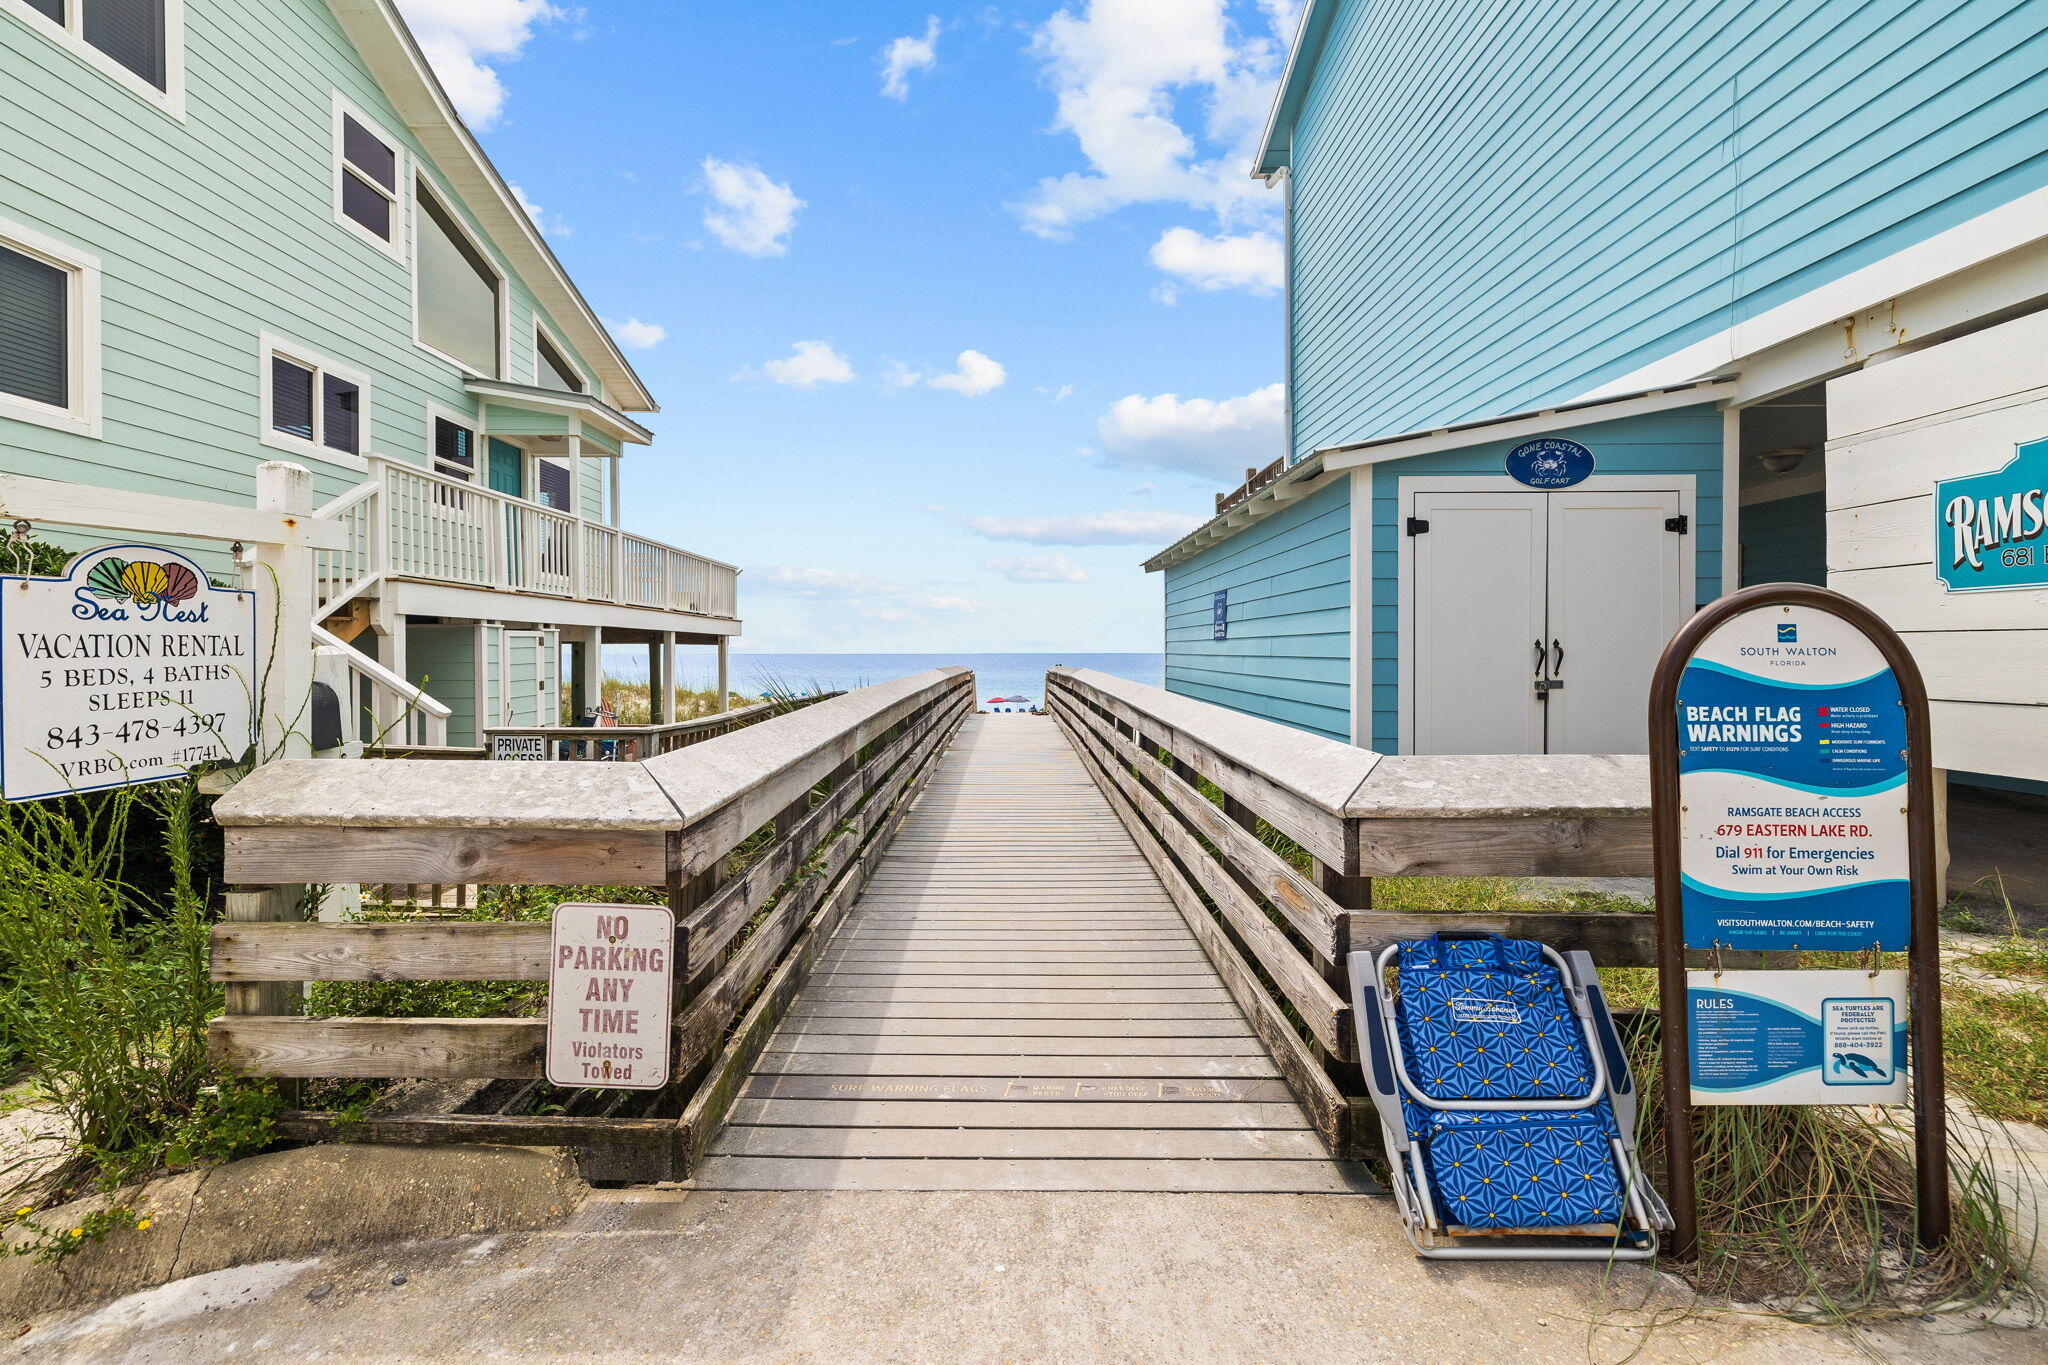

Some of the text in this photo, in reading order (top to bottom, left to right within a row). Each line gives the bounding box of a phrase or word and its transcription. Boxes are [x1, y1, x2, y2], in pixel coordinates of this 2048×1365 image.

[1518, 442, 1584, 458] GONE COASTAL
[1945, 488, 2048, 571] RAMS
[2001, 546, 2034, 567] 681
[72, 586, 208, 623] Sea Nest
[17, 633, 245, 659] VACATION RENTAL
[1740, 648, 1836, 656] SOUTH WALTON
[40, 664, 230, 688] 5 BEDS, 4 BATHS
[89, 689, 194, 712] SLEEPS 11
[1686, 706, 1801, 722] BEACH FLAG
[47, 713, 226, 750] 843-478-4397
[1687, 724, 1802, 742] WARNINGS
[498, 738, 541, 751] PRIVATE
[60, 745, 219, 778] VRBO.com #17741
[1728, 807, 1861, 818] RAMSGATE BEACH ACCESS
[1718, 824, 1872, 837] 679 EASTERN LAKE RD.
[1716, 846, 1874, 862] Dial 911 for Emergencies
[1732, 864, 1858, 876] Swim at Your Own Risk
[596, 915, 629, 940] NO
[1717, 919, 1874, 928] VISITSOUTHWALTON.COM/BEACH-SAFETY
[558, 945, 664, 972] PARKING
[585, 977, 634, 1003] ANY
[1697, 999, 1734, 1008] RULES
[579, 1009, 638, 1034] TIME
[572, 1041, 643, 1060] Violators
[581, 1062, 632, 1080] Towed
[944, 1084, 987, 1092] FLAGS
